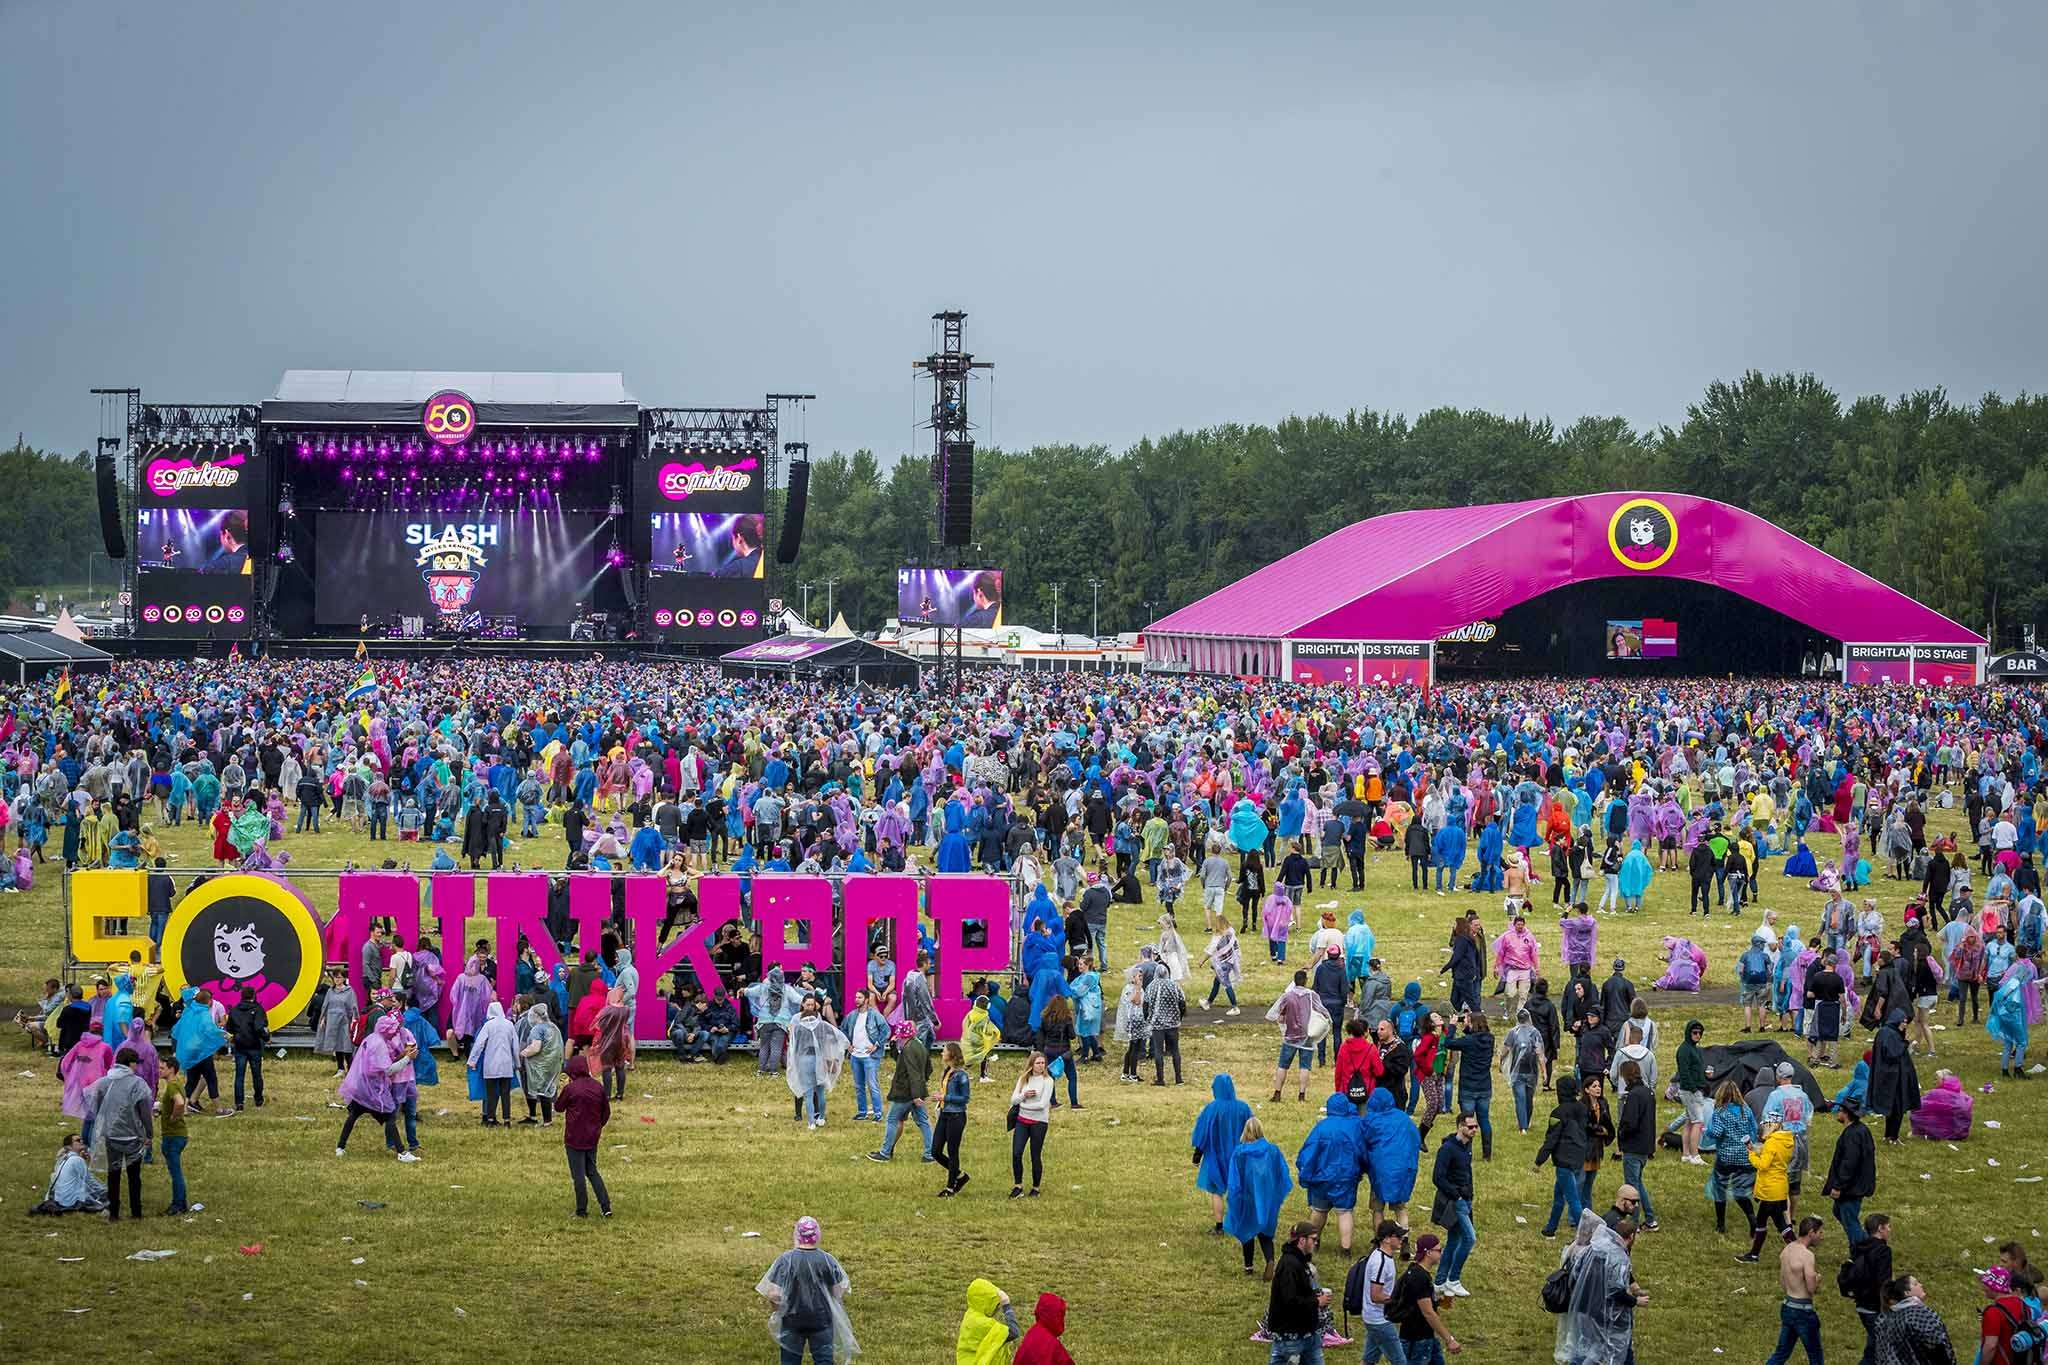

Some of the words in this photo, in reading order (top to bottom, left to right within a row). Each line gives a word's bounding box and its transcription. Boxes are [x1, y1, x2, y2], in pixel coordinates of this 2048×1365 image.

[429, 404, 471, 432] 50
[405, 524, 498, 545] SLASH
[424, 544, 447, 554] MYLES
[448, 544, 479, 554] KENNEDY
[1298, 644, 1381, 655] BRIGHTLANDS
[1383, 645, 1420, 656] STAGE
[1852, 647, 1932, 659] BRIGHTLANDS
[1933, 649, 1968, 660] STAGE
[2007, 658, 2037, 671] BAR
[337, 872, 1012, 1041] PINKPOP
